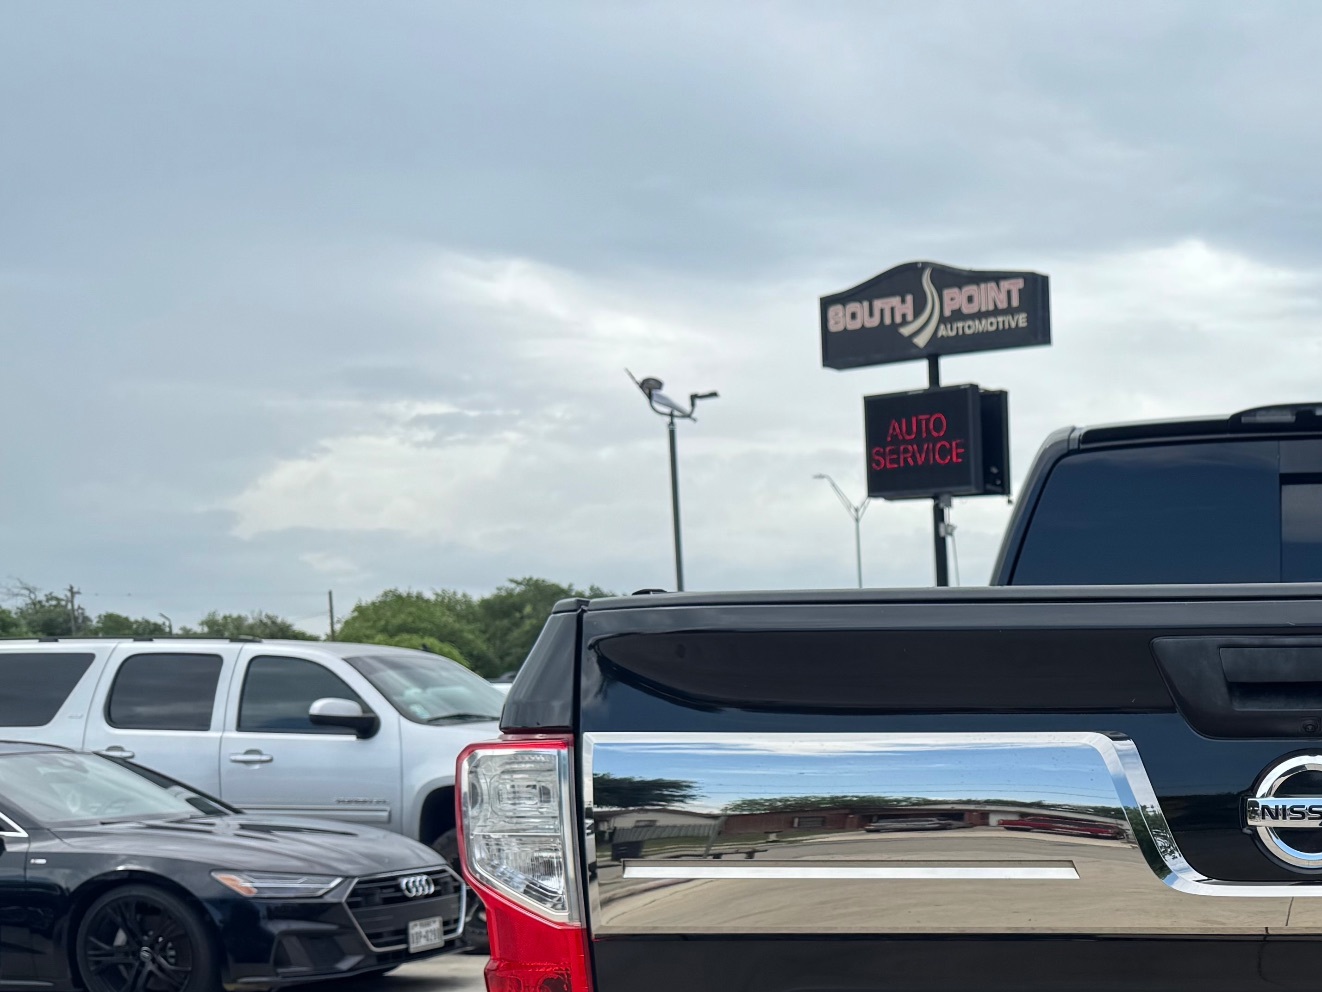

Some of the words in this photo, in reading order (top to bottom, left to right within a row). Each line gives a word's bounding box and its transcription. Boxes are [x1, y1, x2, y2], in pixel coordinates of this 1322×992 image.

[827, 294, 914, 333] SOUTH
[943, 278, 1024, 317] POINT
[937, 313, 1028, 338] AUTOMOTIVE
[887, 413, 947, 441] AUTO
[871, 439, 965, 471] SERVICE
